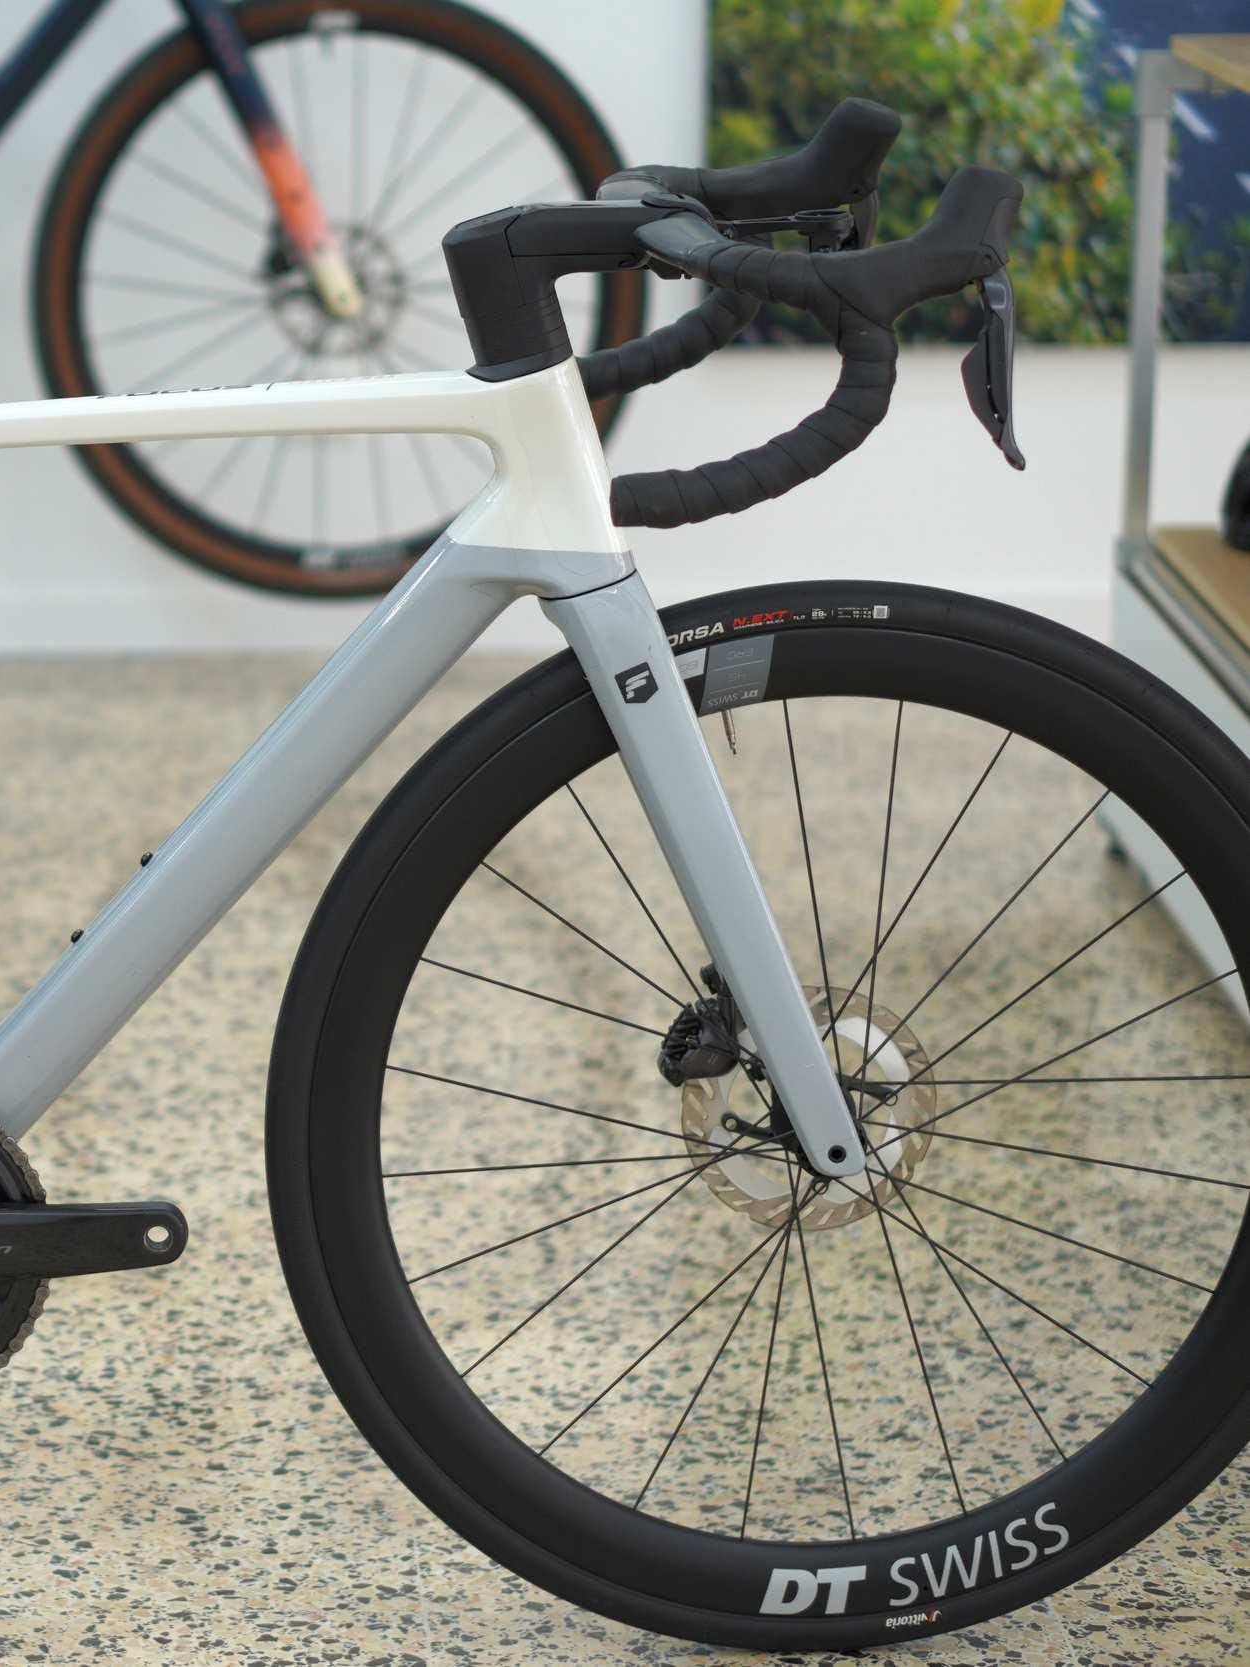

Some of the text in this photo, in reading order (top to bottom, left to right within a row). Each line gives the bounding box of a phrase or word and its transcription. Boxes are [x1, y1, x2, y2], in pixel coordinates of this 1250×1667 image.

[666, 621, 725, 648] ORSA
[759, 1502, 1070, 1615] DT SWISS
[885, 1612, 929, 1628] vittoria
